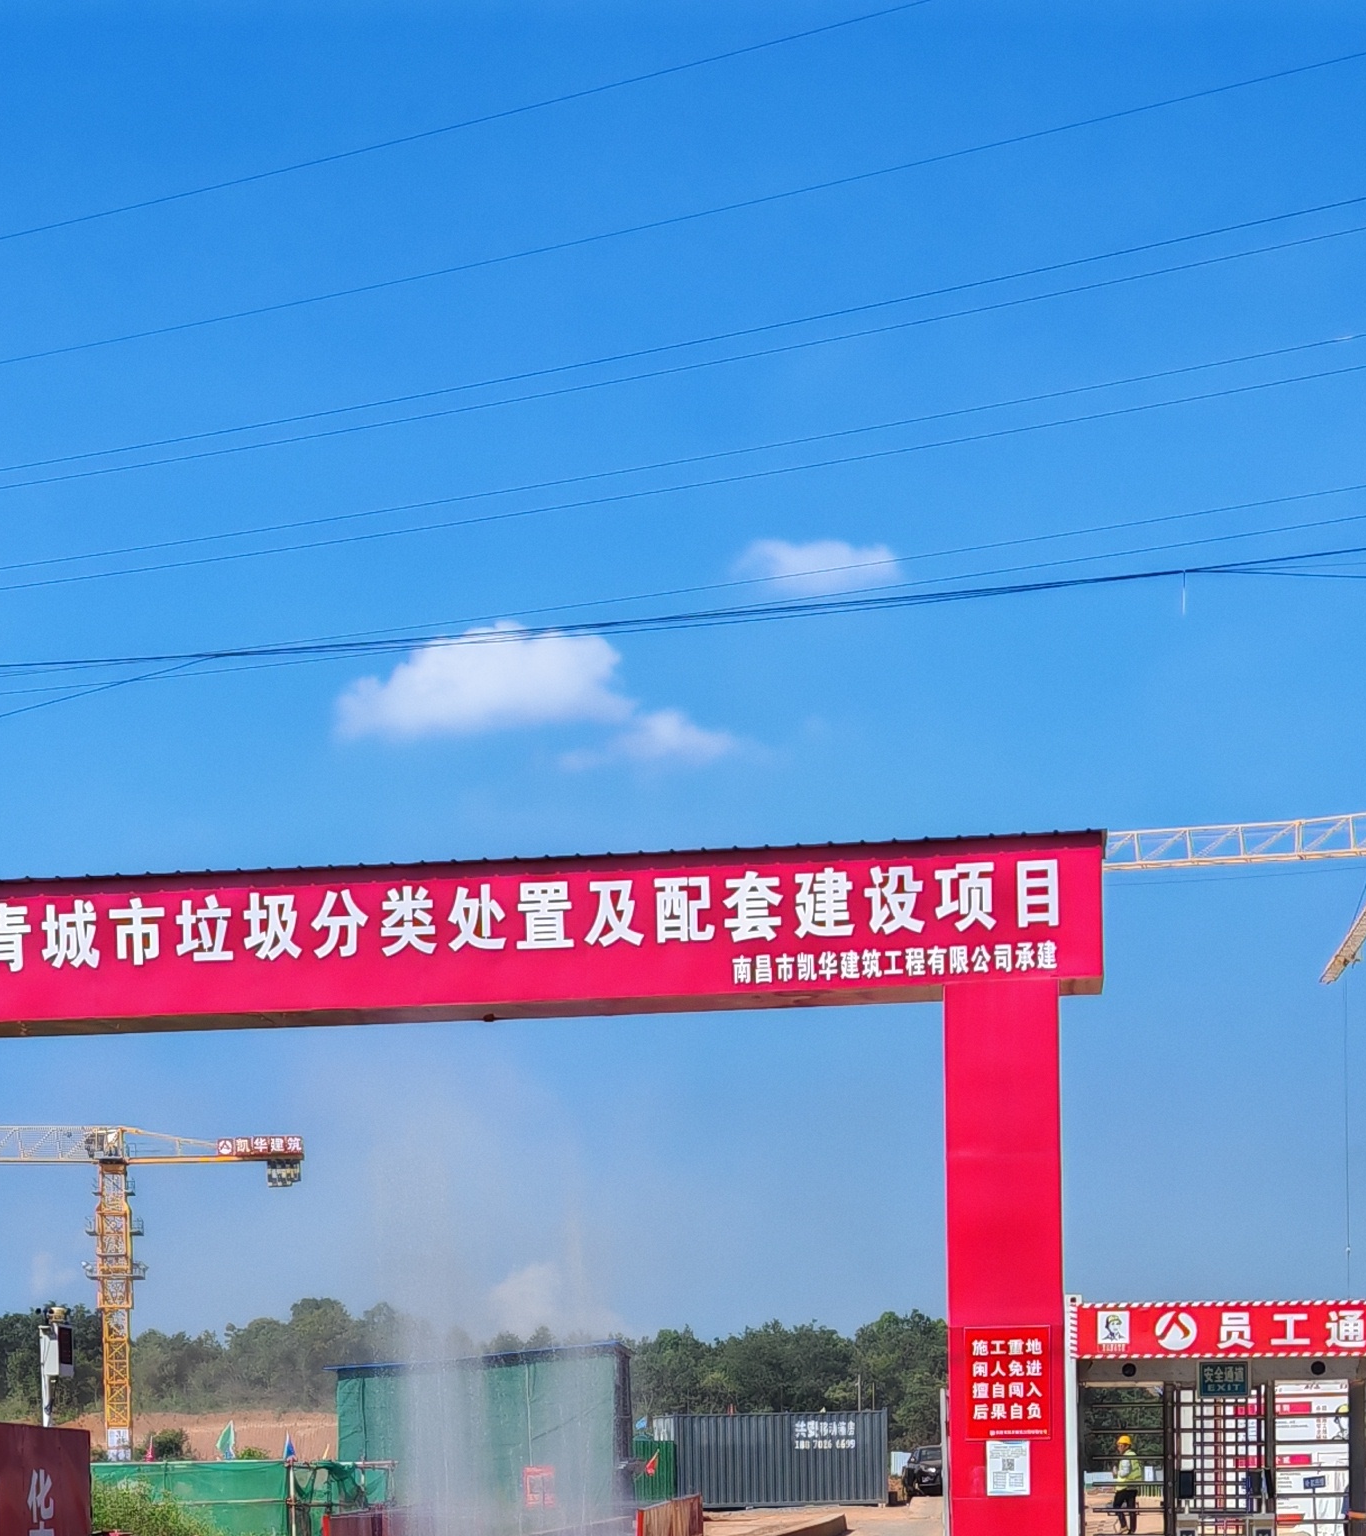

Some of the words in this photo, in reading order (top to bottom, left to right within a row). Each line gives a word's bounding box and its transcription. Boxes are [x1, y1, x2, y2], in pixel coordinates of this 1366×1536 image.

[732, 939, 1058, 985] 南昌市凯华建筑工程有限公司承建
[236, 1136, 302, 1153] 凯华建筑
[972, 1338, 1043, 1356] 施工重地
[972, 1360, 1042, 1377] 闲人免进
[1204, 1366, 1244, 1383] 安全通道
[972, 1382, 1043, 1399] 擅自闯入
[1207, 1384, 1241, 1392] EXIT
[973, 1402, 1042, 1420] 后果自负
